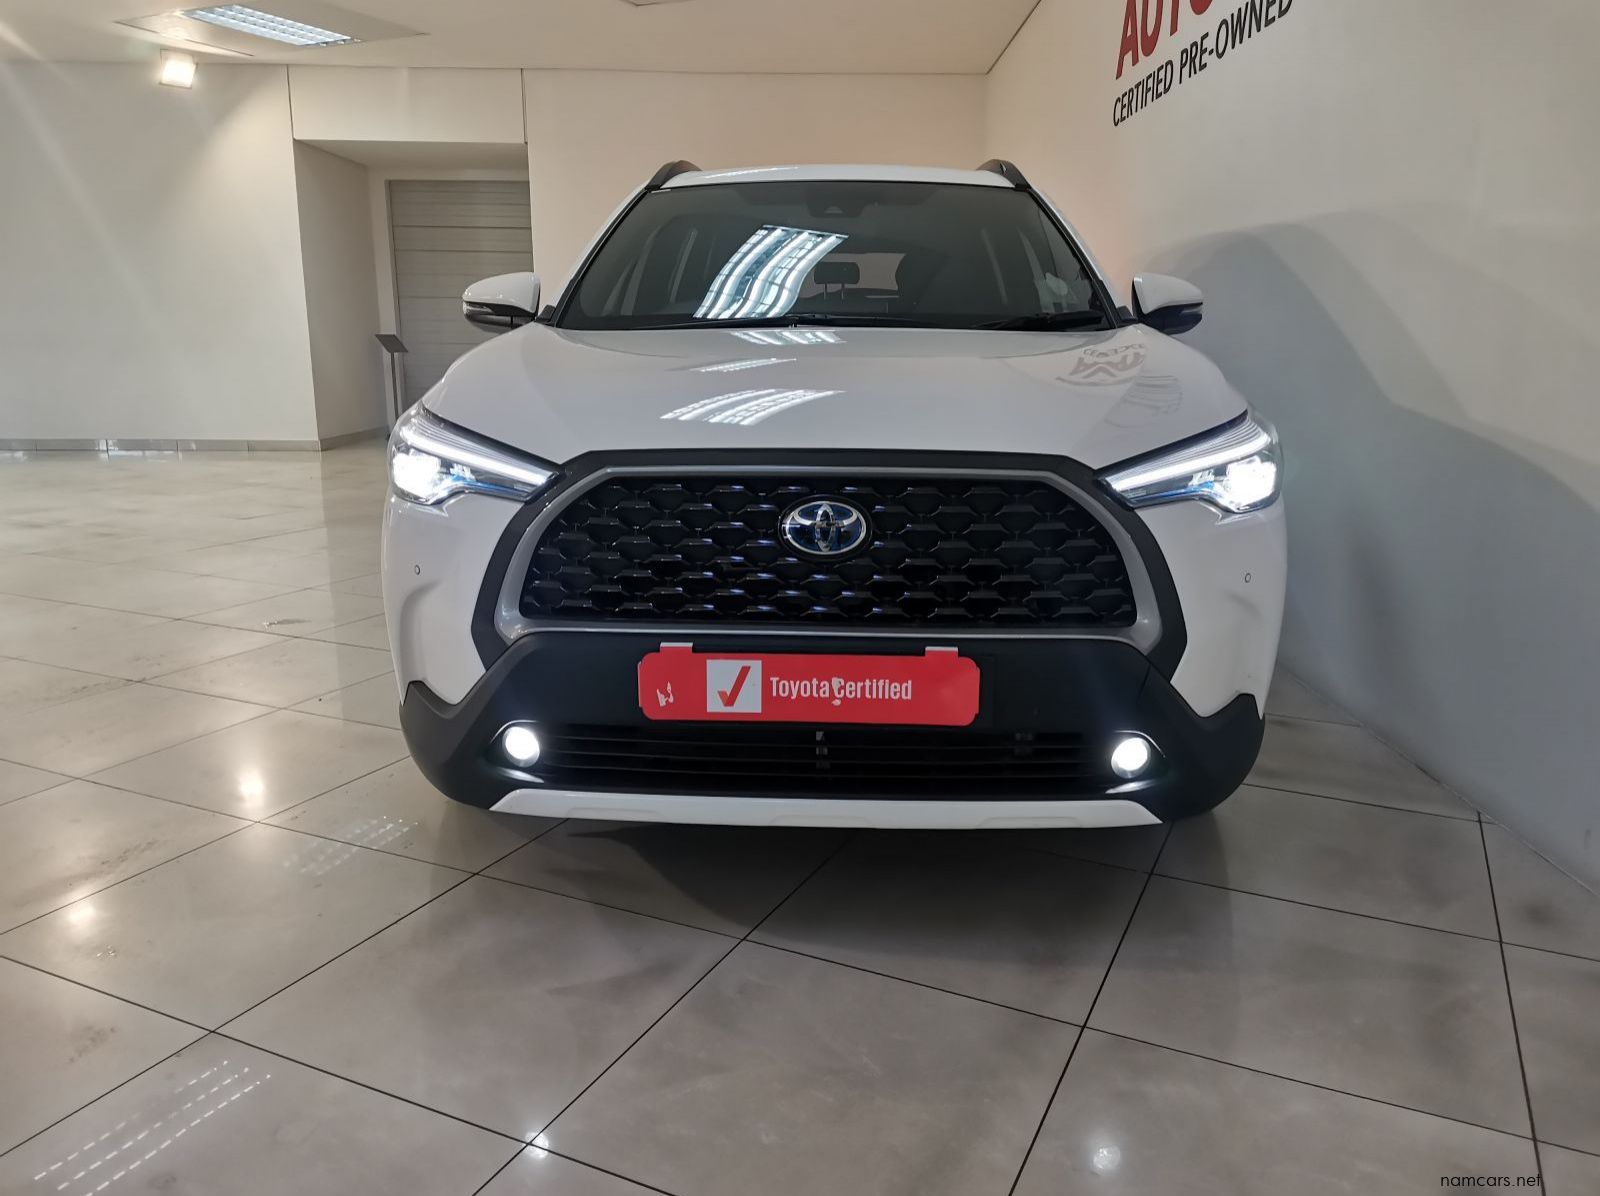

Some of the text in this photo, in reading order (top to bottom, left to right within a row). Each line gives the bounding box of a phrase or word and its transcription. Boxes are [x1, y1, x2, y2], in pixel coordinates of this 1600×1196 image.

[1115, 0, 1213, 80] AU
[1112, 59, 1174, 127] CERTIFIED
[769, 676, 912, 700] Toyota Certified
